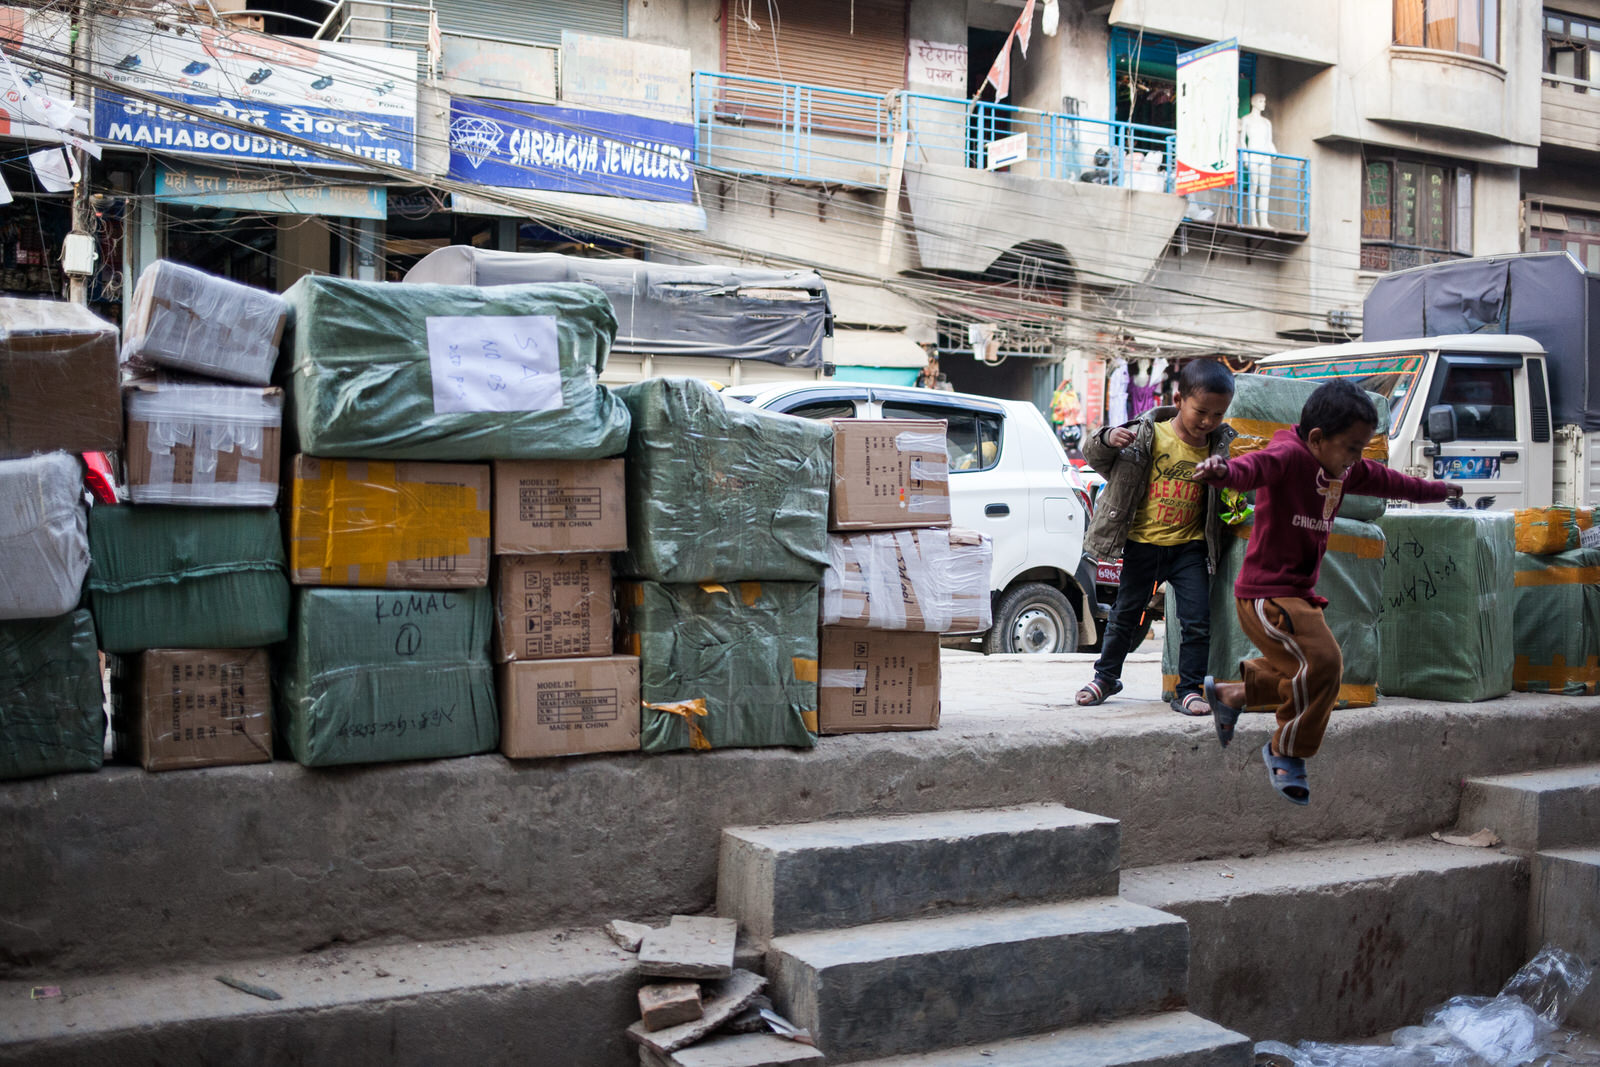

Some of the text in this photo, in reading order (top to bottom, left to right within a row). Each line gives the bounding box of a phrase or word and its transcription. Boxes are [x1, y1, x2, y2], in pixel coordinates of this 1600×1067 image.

[108, 123, 308, 157] MAHABOUDHA
[509, 129, 599, 175] SARBAGYA
[601, 139, 691, 182] JEWELLERS
[1153, 453, 1198, 482] Supe
[553, 571, 562, 586] PCS
[562, 571, 571, 586] KGS
[572, 570, 580, 585] KGS
[553, 611, 563, 626] 100
[542, 634, 553, 653] ITEM
